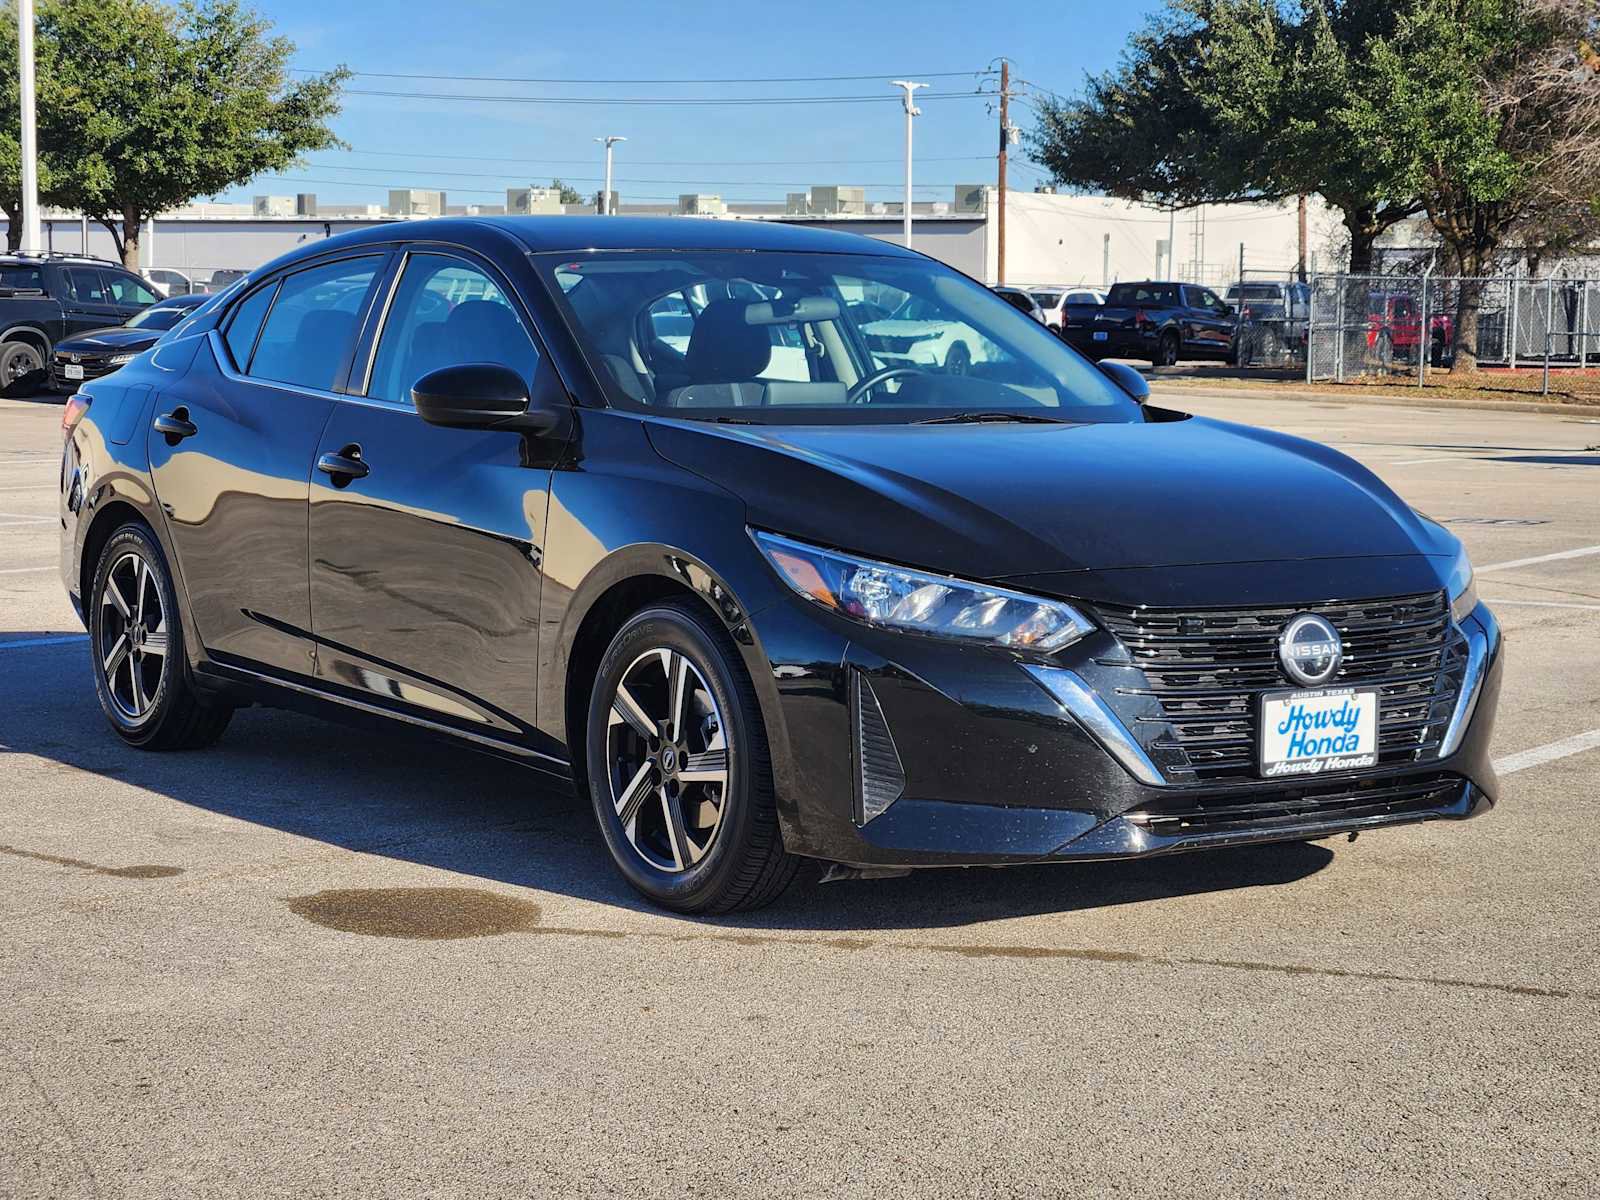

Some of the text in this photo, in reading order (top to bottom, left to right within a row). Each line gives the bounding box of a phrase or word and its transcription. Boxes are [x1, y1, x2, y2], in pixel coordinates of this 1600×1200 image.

[1285, 641, 1340, 657] NISSAN
[1291, 688, 1355, 699] AUSTIN TEXAS
[1278, 700, 1361, 734] Howdy
[1287, 731, 1360, 759] Honda
[1266, 754, 1374, 775] Howdy Honda
